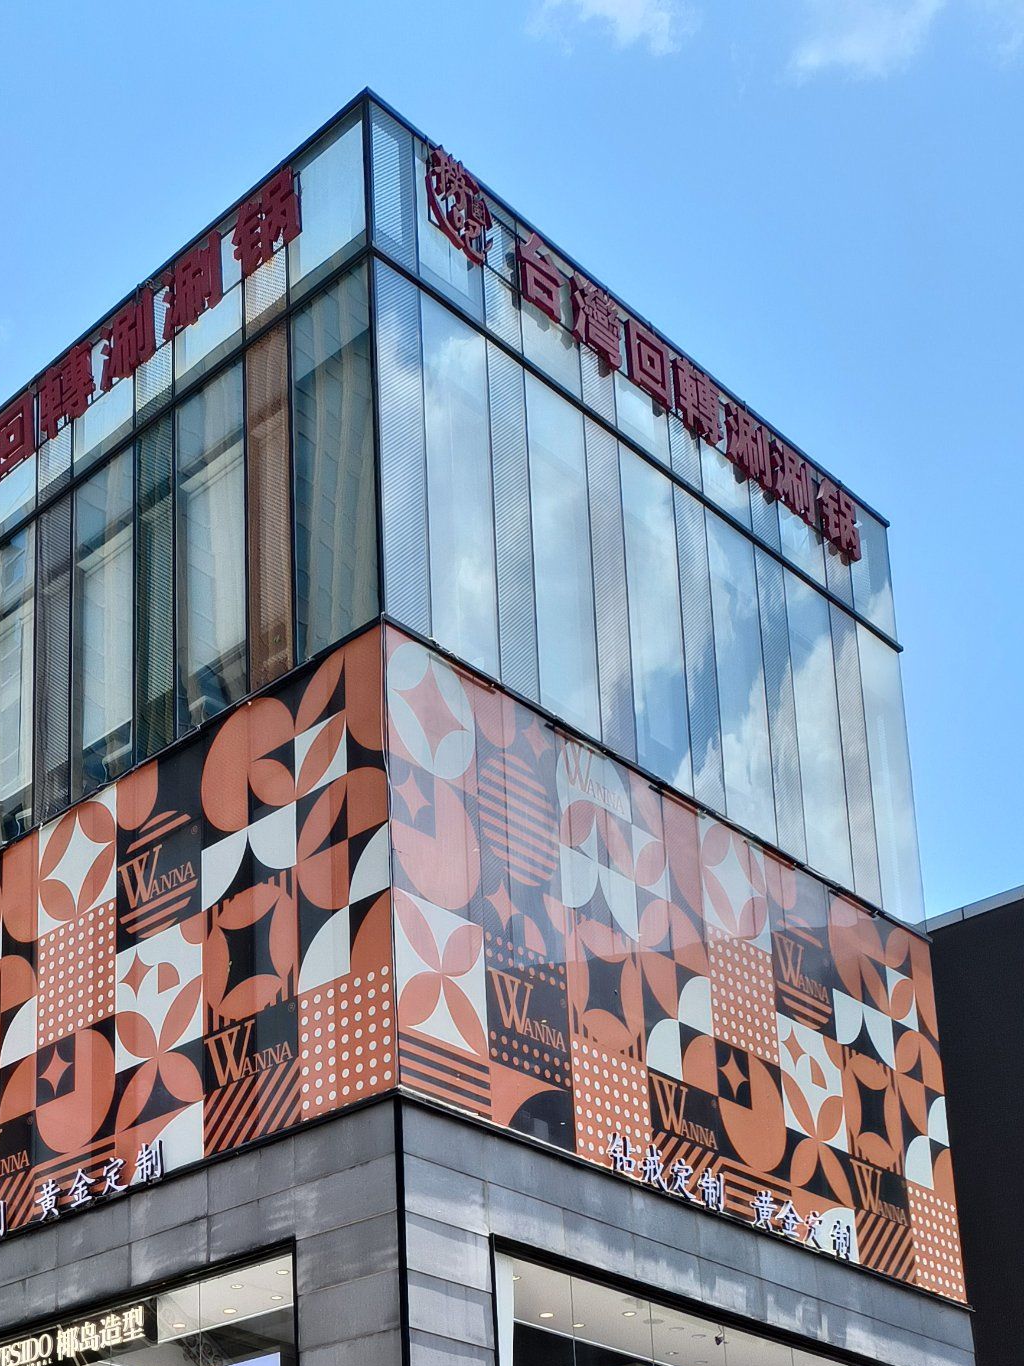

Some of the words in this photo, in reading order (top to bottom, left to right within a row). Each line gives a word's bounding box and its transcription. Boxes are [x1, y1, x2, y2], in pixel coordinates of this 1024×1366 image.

[118, 845, 196, 907] WANNA
[776, 936, 829, 1003] WANNA
[488, 967, 567, 1052] WANNA
[203, 1018, 293, 1088] WANNA
[649, 1074, 719, 1150] WANNA
[38, 1138, 166, 1218] 黄金定制
[606, 1132, 724, 1212] 钻戒定制
[751, 1190, 858, 1259] 黄金定制
[850, 1158, 907, 1226] WANNA
[56, 1305, 146, 1361] 椰岛造型
